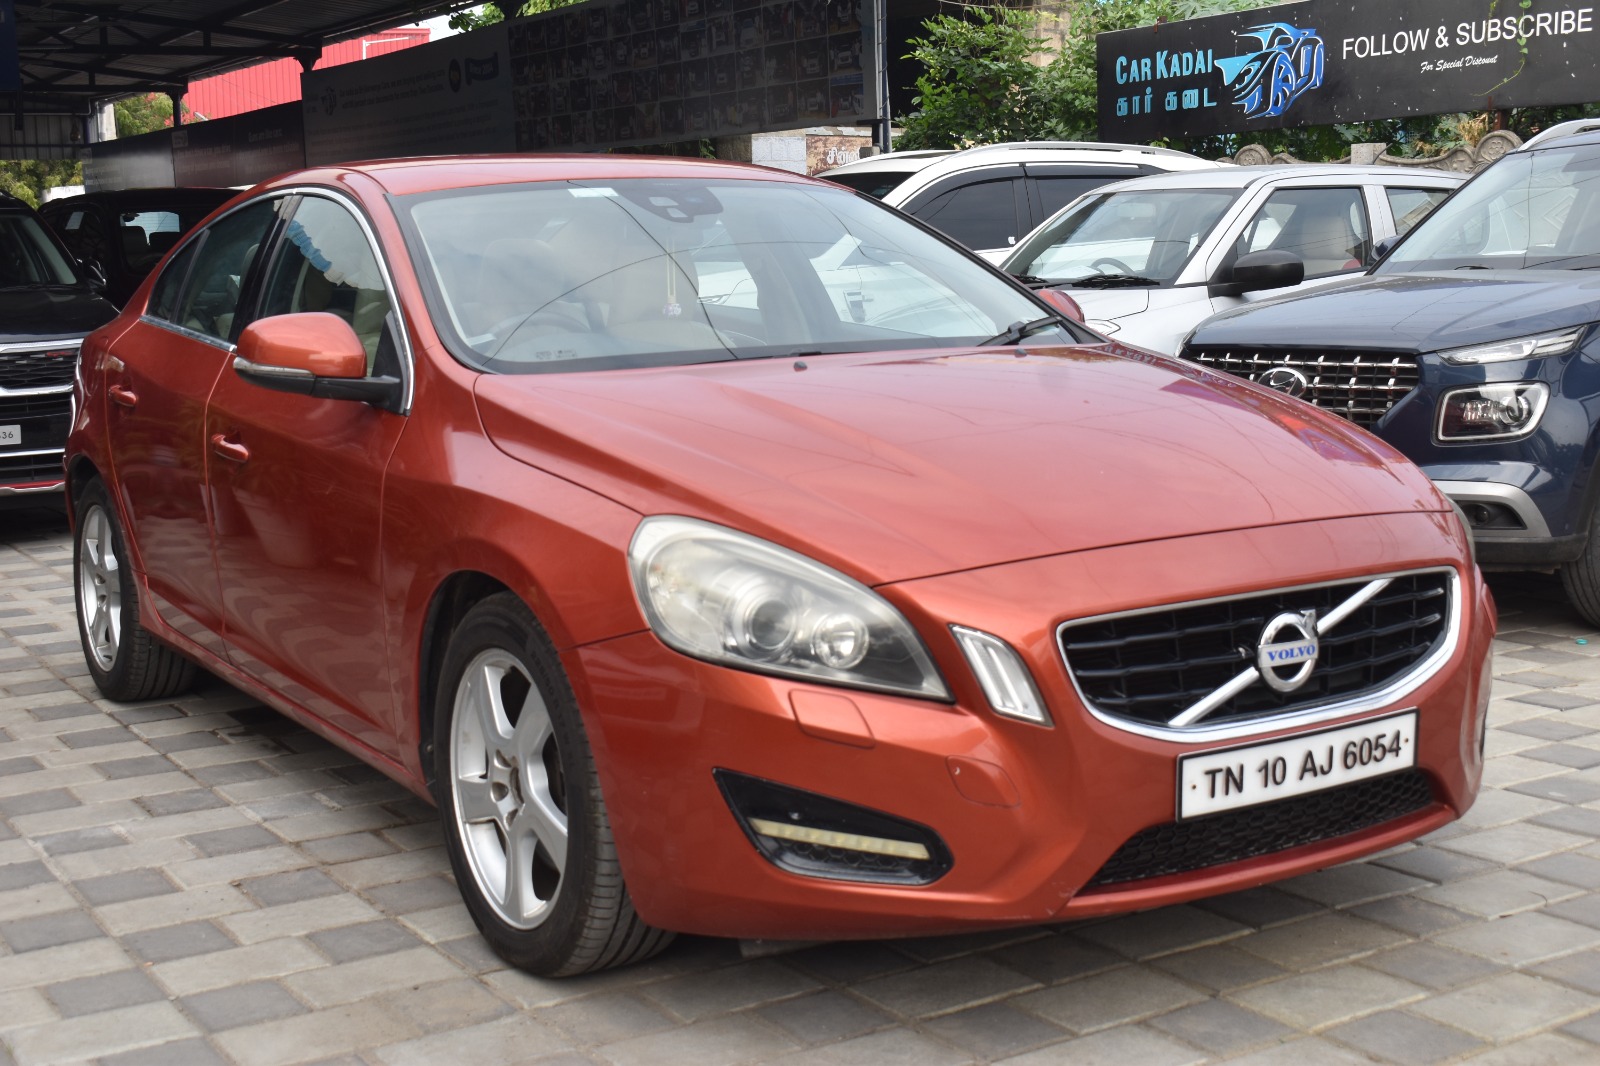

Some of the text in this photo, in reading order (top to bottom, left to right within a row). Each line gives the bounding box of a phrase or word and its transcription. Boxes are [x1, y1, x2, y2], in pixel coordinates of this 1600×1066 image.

[1342, 8, 1593, 60] FOLLOW & SUBSCRIBE
[1116, 48, 1213, 85] CAR KADAI
[1420, 54, 1498, 73] For Special Discount
[1116, 86, 1153, 117] கார்
[0, 431, 14, 439] 36
[1267, 644, 1316, 661] VOLVO
[1204, 729, 1402, 798] TN 10 AJ 6054
